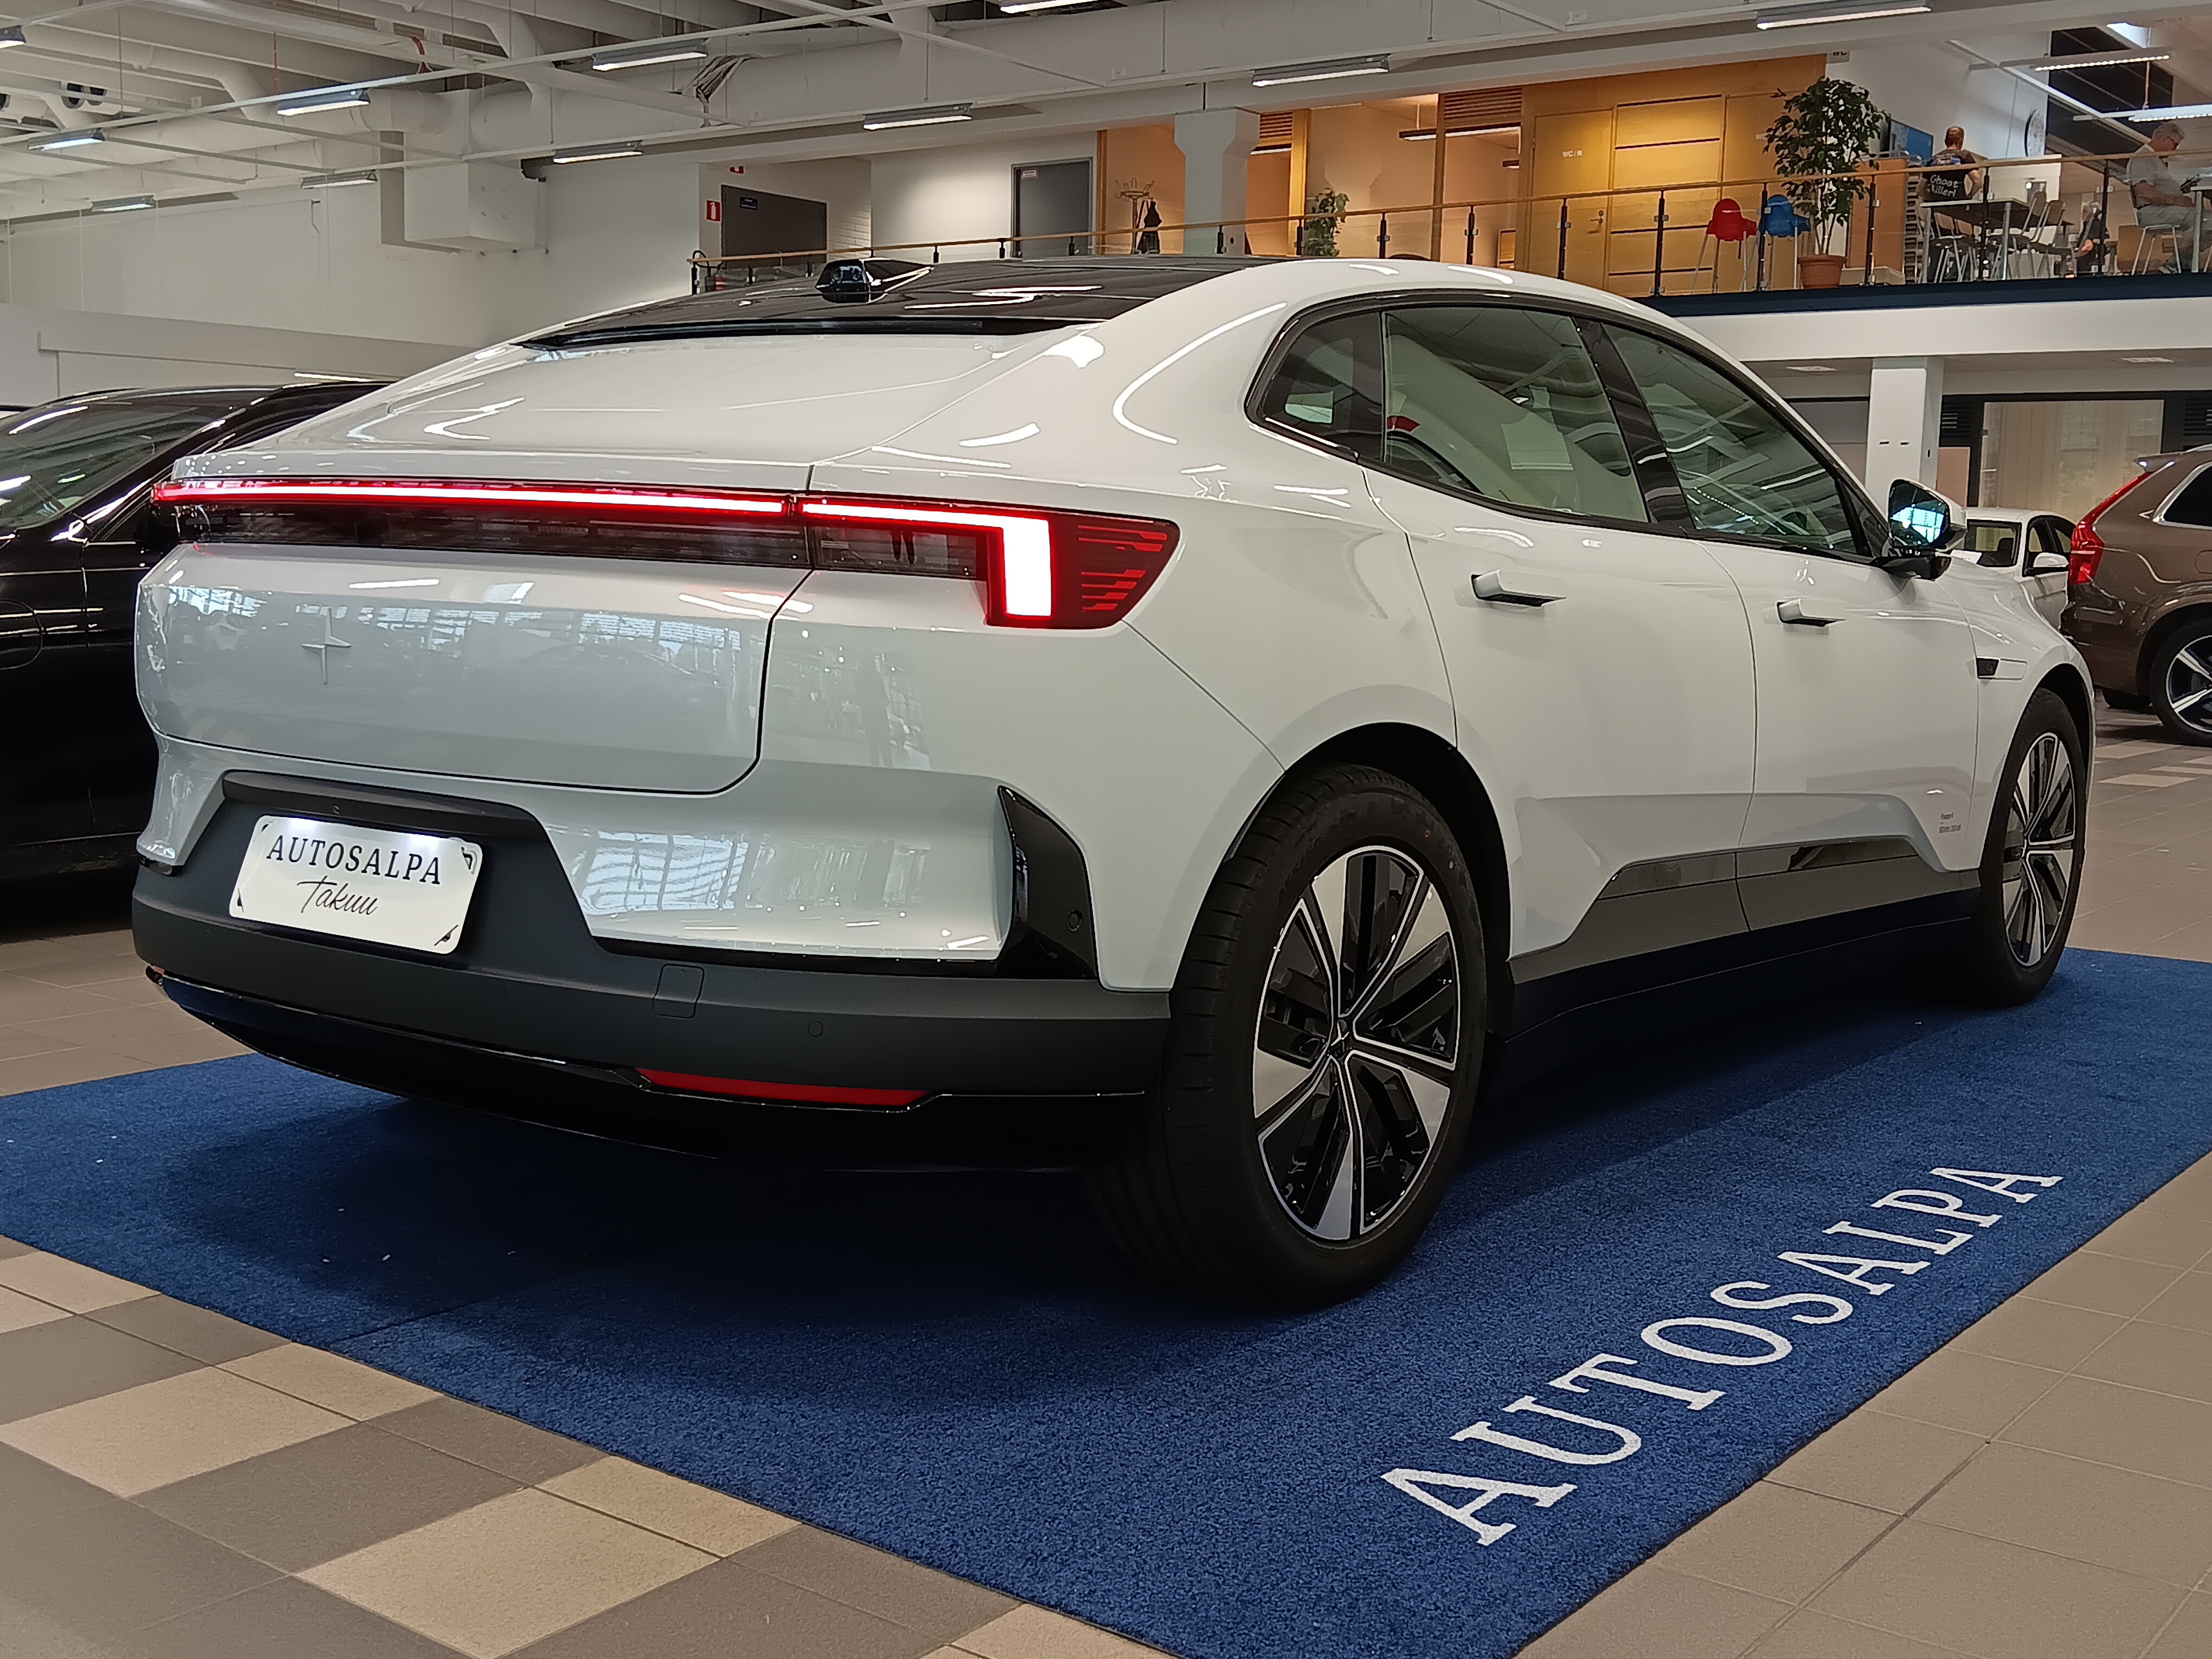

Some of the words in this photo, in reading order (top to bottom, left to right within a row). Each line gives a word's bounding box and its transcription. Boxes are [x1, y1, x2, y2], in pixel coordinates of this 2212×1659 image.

[266, 835, 441, 885] AUTOSALPA
[296, 875, 378, 915] Takuu
[1380, 1167, 2064, 1546] AUTOSALPA
